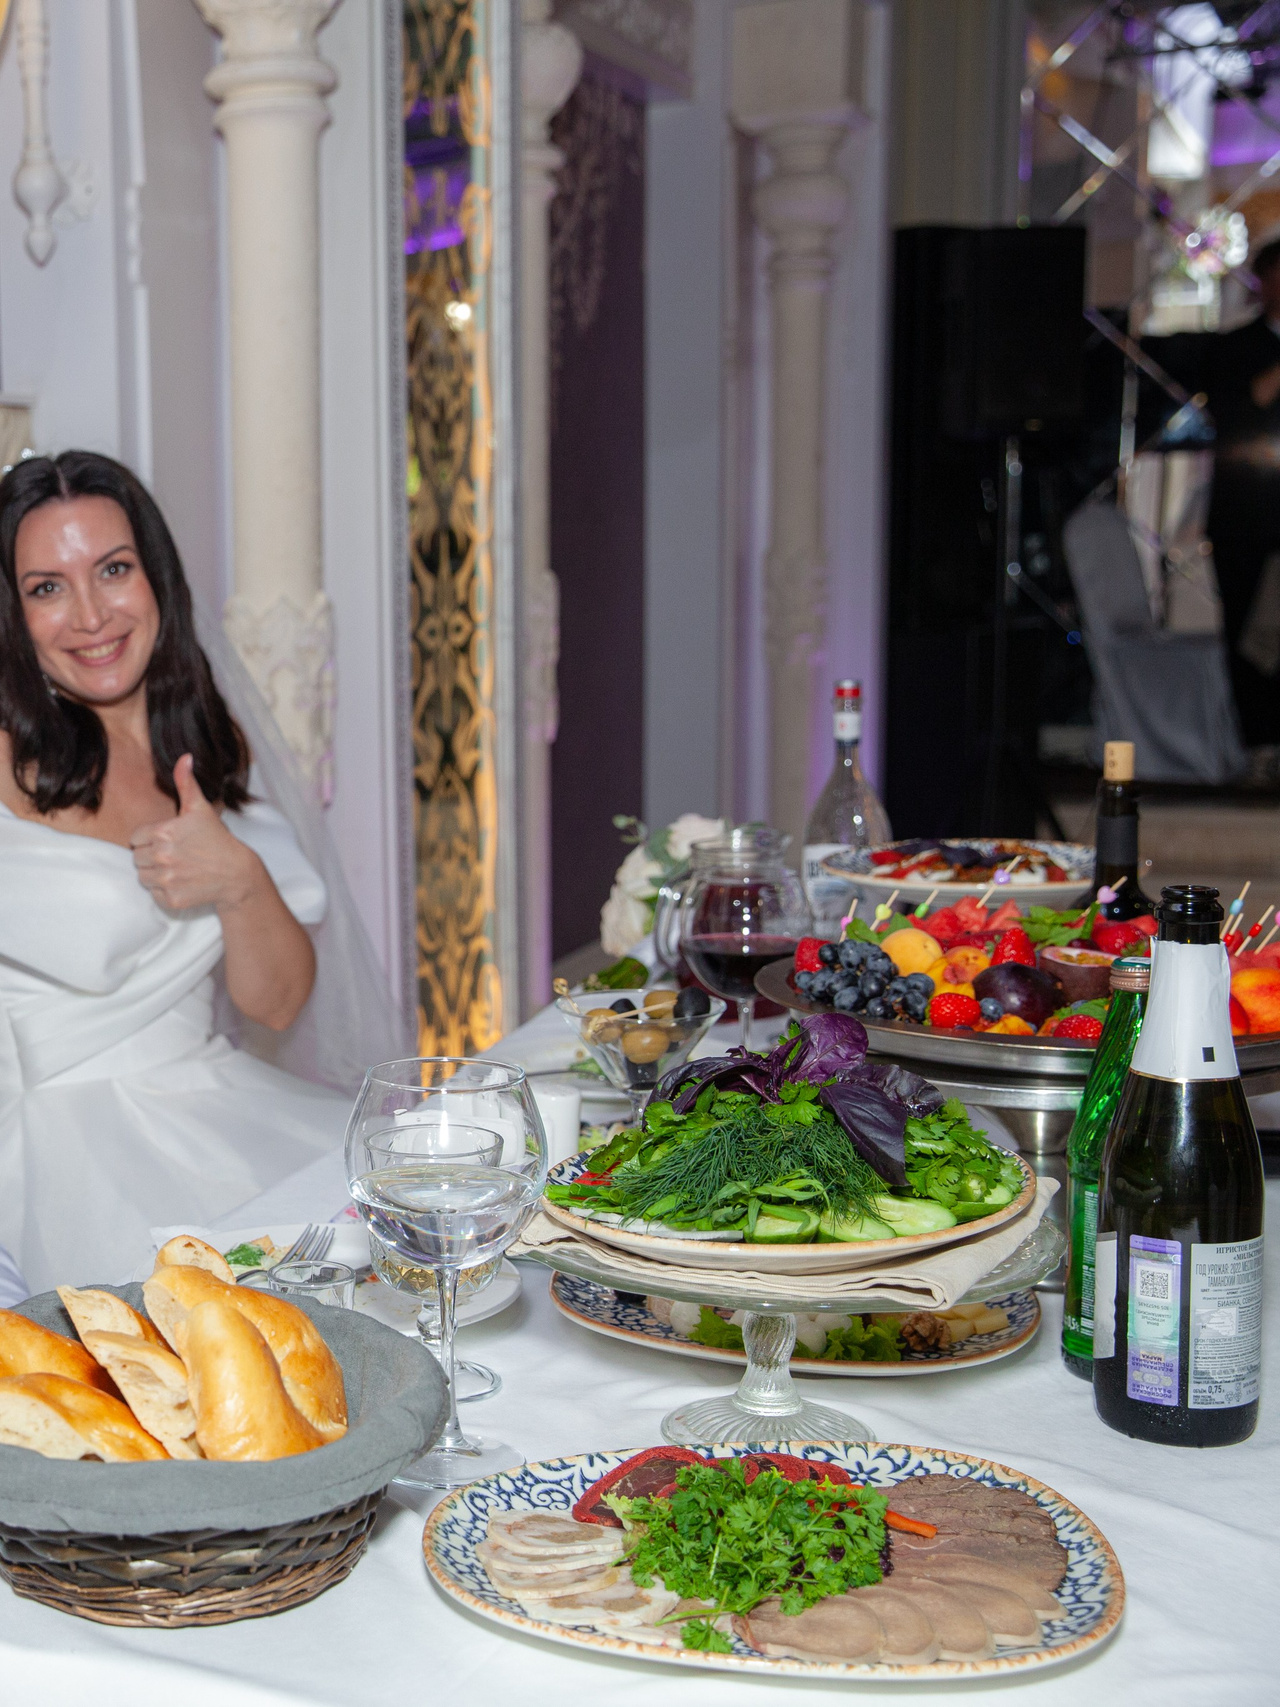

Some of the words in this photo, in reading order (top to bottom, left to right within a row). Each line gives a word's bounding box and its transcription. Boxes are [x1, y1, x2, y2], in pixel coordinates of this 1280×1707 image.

[1216, 1245, 1248, 1254] ИГРИСТОЕ
[1196, 1264, 1207, 1276] ГОД
[1217, 1298, 1241, 1308] БИАНКА,
[1141, 1353, 1163, 1362] МАРКА
[1131, 1388, 1173, 1399] РОССИЙСКАЯ
[1132, 1383, 1172, 1394] ФЕДЕРАЦИЯ
[1207, 1384, 1222, 1395] 0,75
